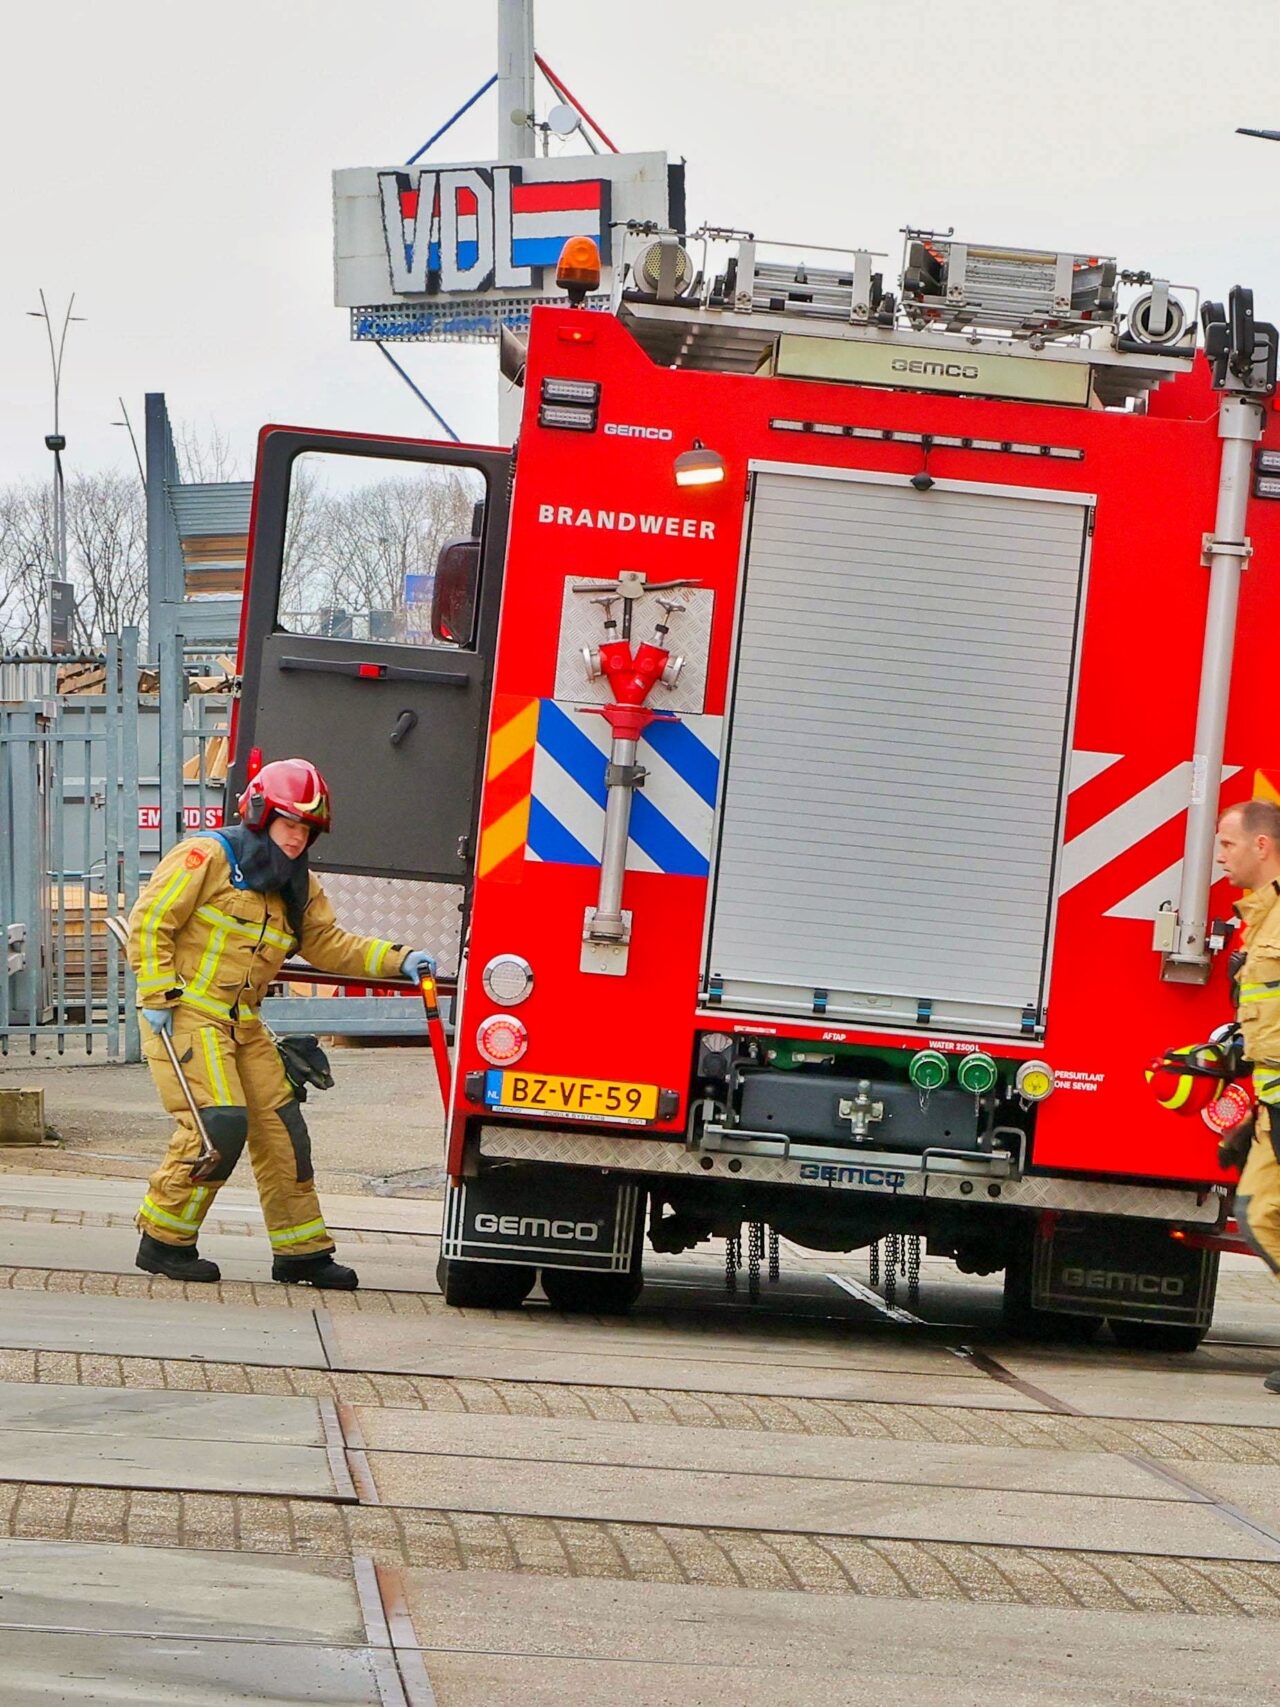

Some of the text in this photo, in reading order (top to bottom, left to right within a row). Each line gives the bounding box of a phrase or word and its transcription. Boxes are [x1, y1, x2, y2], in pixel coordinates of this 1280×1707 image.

[378, 166, 538, 293] VDL
[891, 358, 979, 379] GEMCO
[604, 423, 673, 441] GEMCO
[538, 504, 716, 540] BRANDWEER
[822, 1032, 847, 1041] AFTAP
[929, 1040, 955, 1050] WATER
[956, 1042, 975, 1052] 2500
[1054, 1070, 1105, 1082] PERSUITLAAT
[1054, 1080, 1098, 1092] ONE SEVEN
[487, 1090, 500, 1100] NL
[512, 1077, 642, 1112] BZ-VF-59
[800, 1164, 905, 1188] GEMCO
[474, 1213, 599, 1242] GEMCO
[1062, 1268, 1184, 1296] GEMCO
